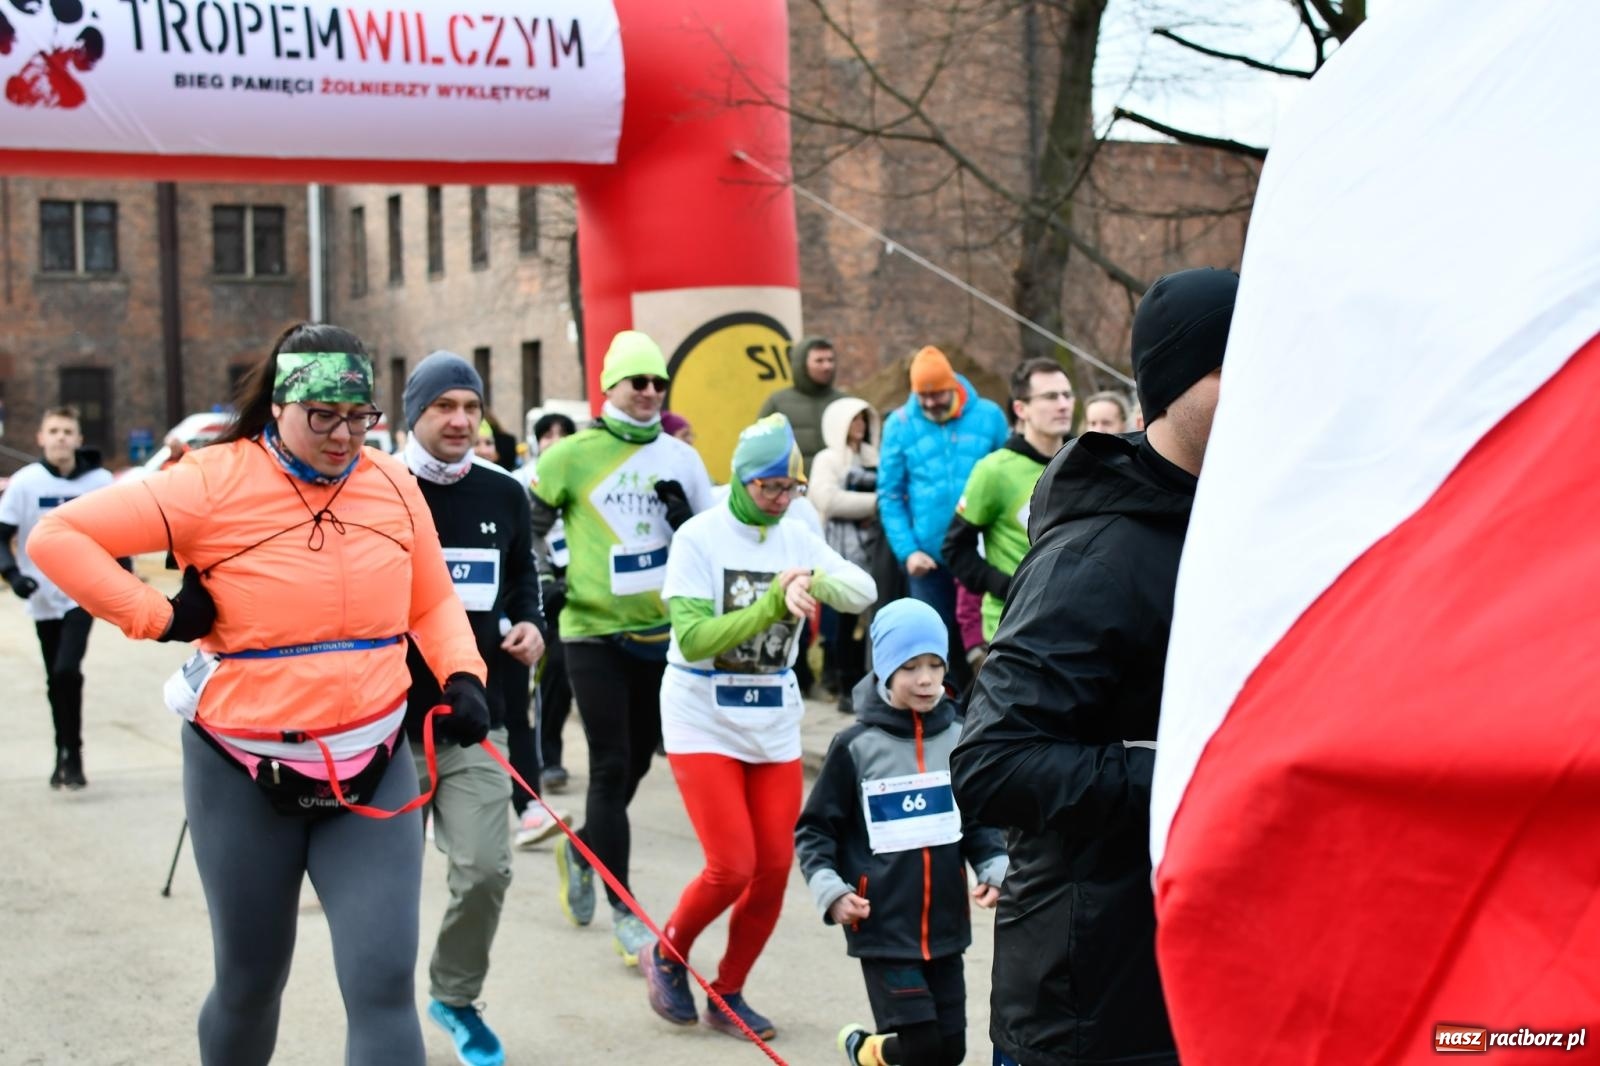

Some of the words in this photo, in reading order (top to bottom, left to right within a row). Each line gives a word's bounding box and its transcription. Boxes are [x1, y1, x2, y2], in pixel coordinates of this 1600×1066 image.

[173, 73, 225, 90] BIEG
[231, 76, 315, 97] PAMIĘCI
[320, 77, 431, 97] ŻOŁNIERZY
[436, 82, 551, 103] WYKLĘTYCH
[451, 563, 472, 580] 67
[743, 688, 760, 704] 61
[902, 793, 927, 813] 66
